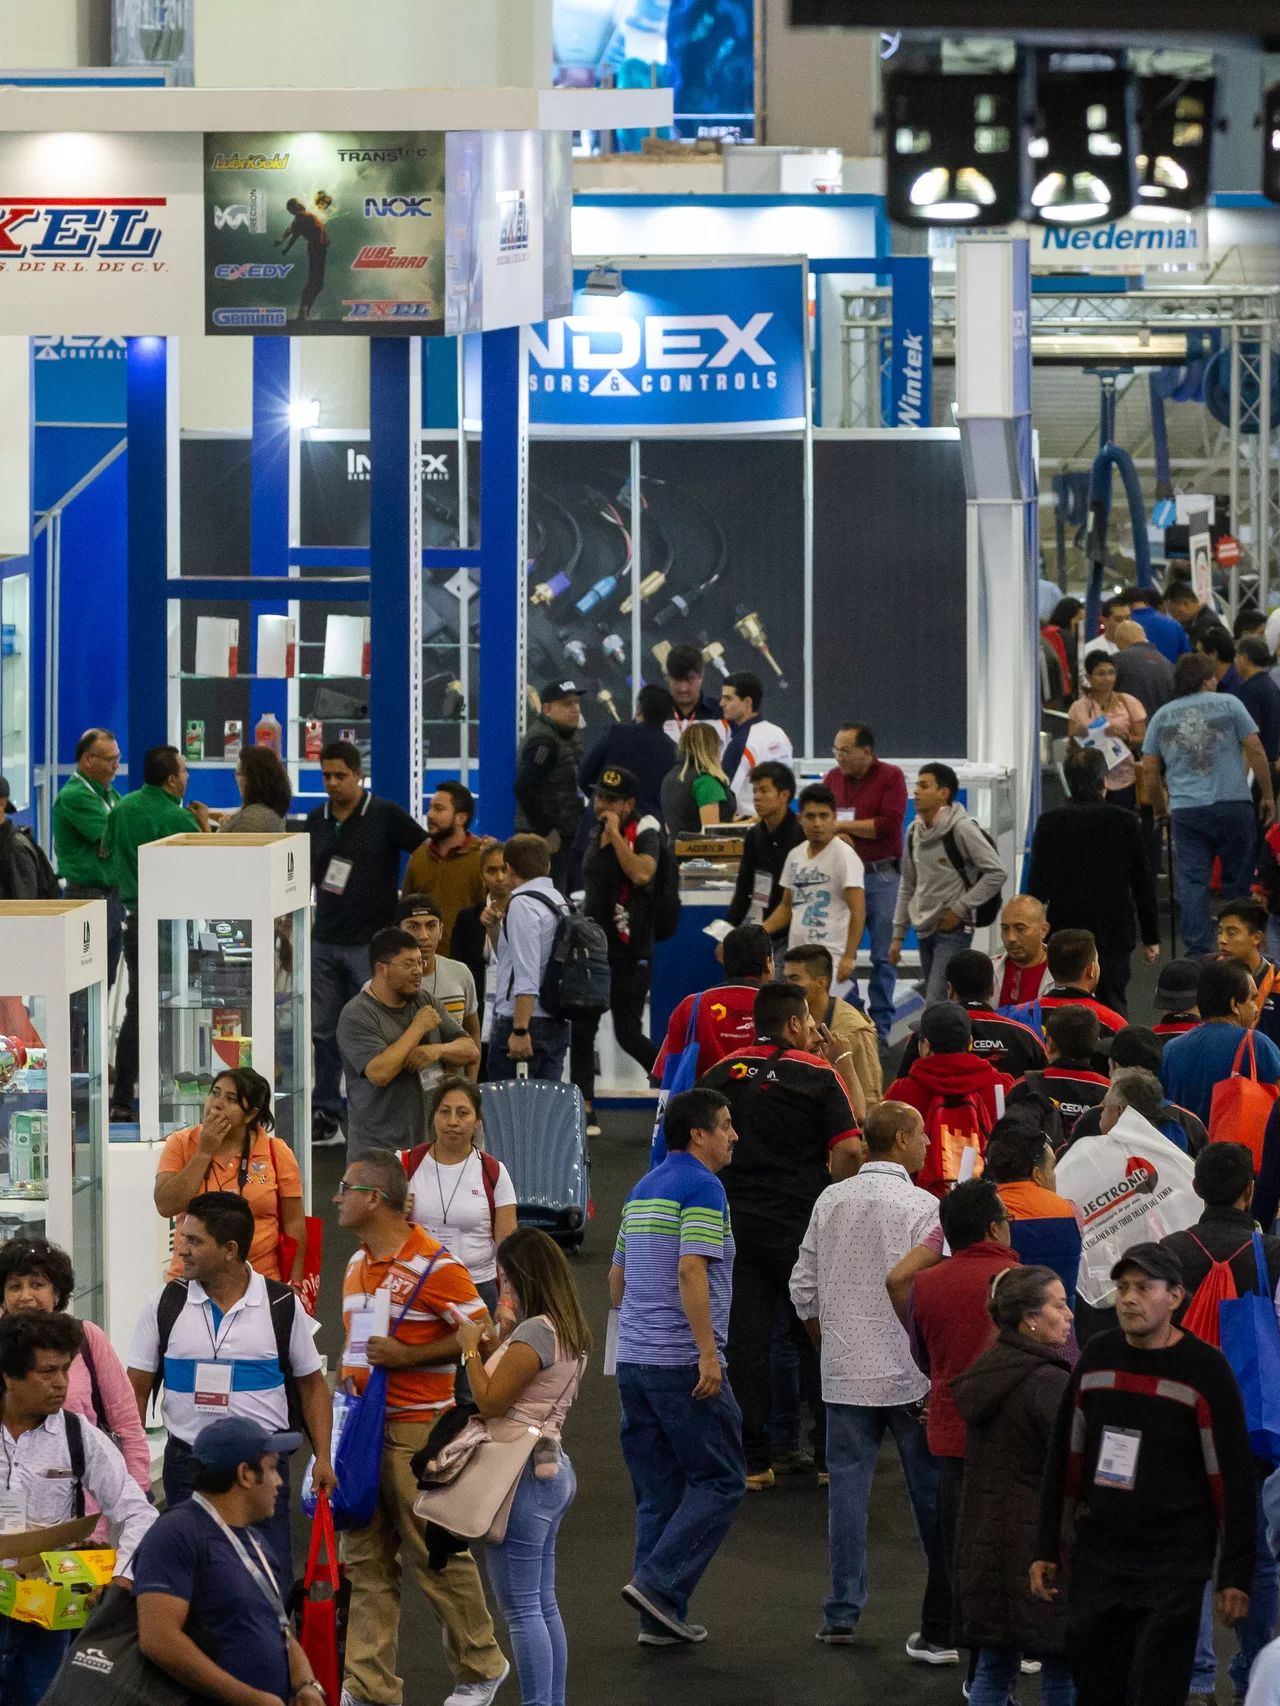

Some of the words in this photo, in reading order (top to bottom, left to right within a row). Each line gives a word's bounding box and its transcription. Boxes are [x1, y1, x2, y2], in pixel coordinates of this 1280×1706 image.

[212, 153, 290, 171] LubriGold
[364, 197, 432, 217] NOK
[1043, 223, 1198, 249] Nederman
[18, 262, 45, 272] DE
[52, 262, 89, 272] R.L.
[97, 262, 124, 272] DE
[131, 262, 169, 272] C.V.
[215, 264, 294, 280] EXEDY
[213, 307, 286, 326] Genuine
[350, 303, 430, 317] EXEL
[641, 371, 777, 393] CONTROLS
[898, 329, 923, 428] Wintek
[974, 1040, 1004, 1049] CEDVA
